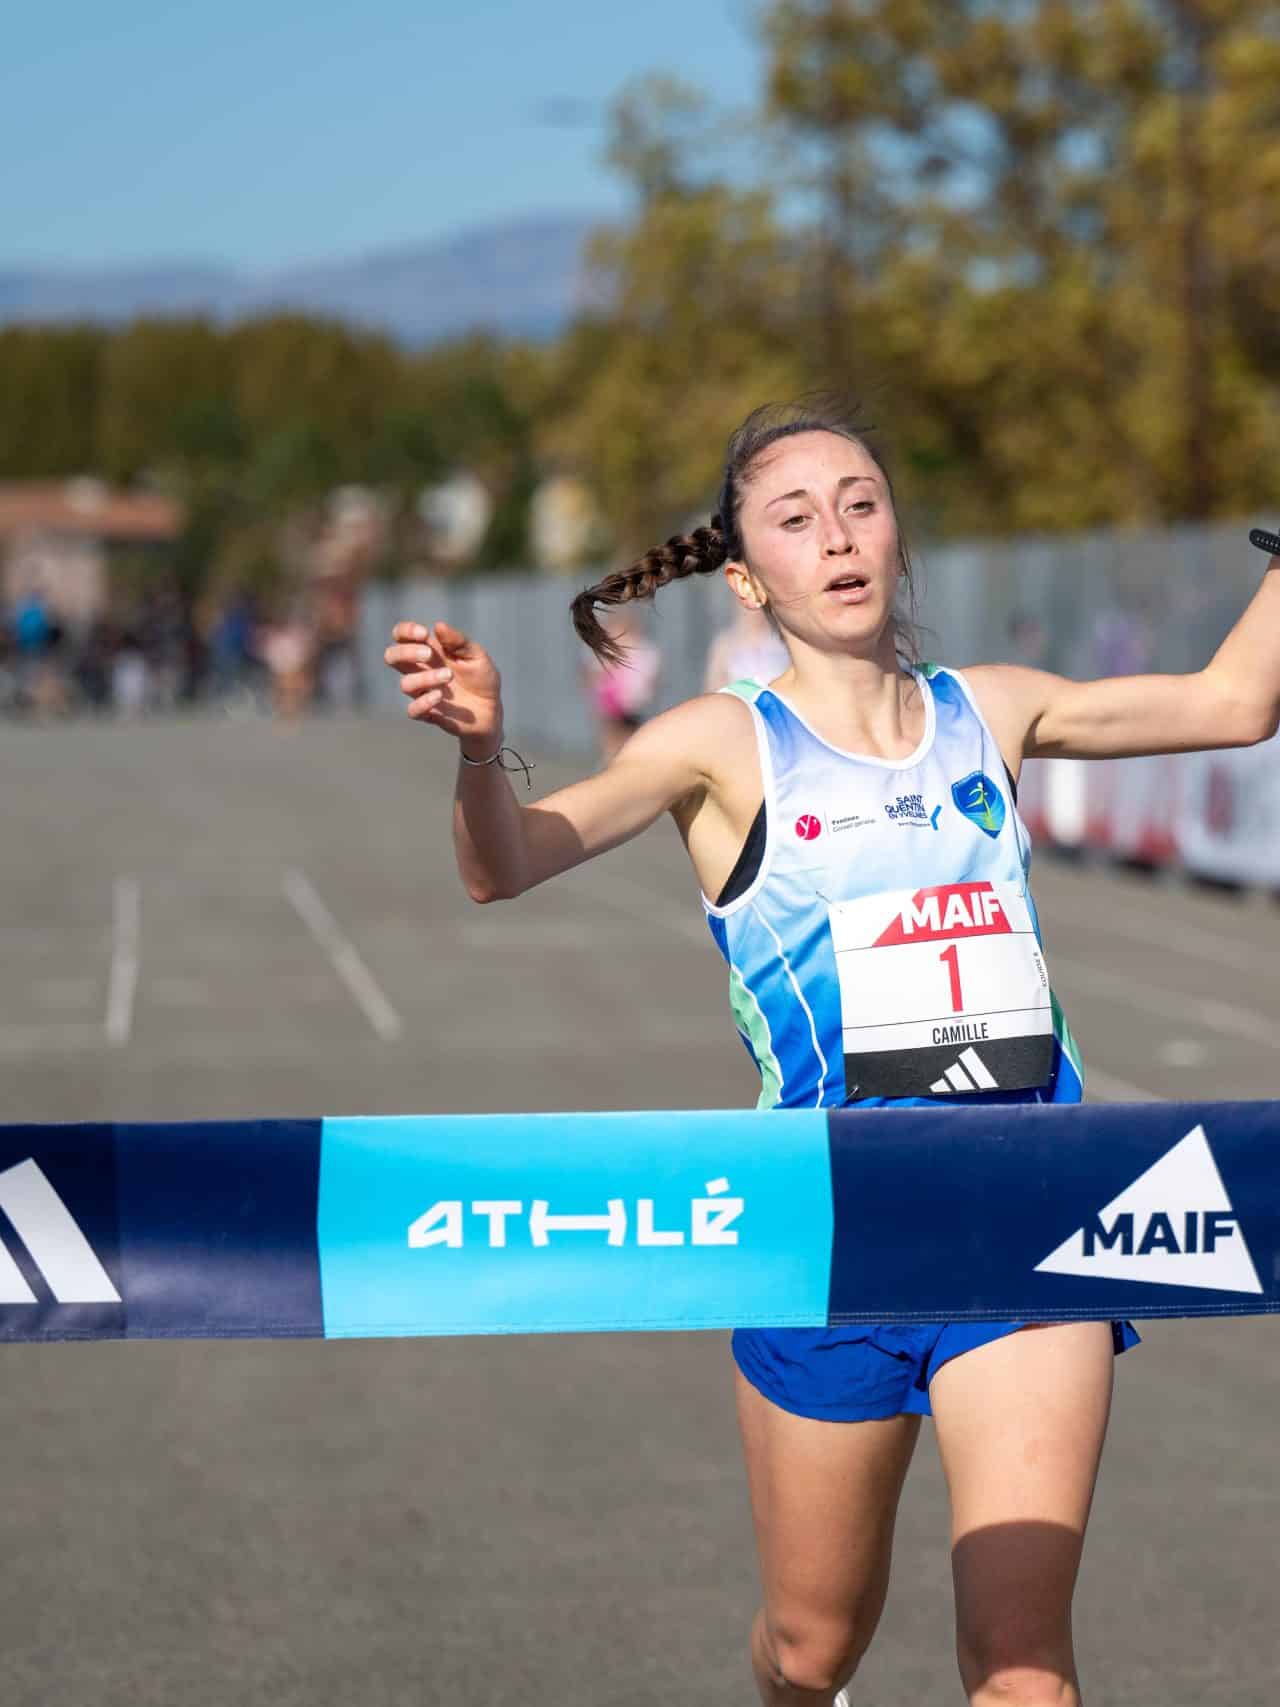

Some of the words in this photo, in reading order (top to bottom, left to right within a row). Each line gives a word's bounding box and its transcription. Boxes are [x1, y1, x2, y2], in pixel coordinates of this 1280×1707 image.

[884, 803, 926, 815] QUENTIN
[896, 794, 923, 804] SAINT
[901, 891, 1000, 934] MAIF
[939, 944, 963, 1012] 1
[932, 1022, 989, 1045] CAMILLE
[408, 1177, 744, 1248] ATHLÉ
[1082, 1211, 1237, 1256] MAIF
